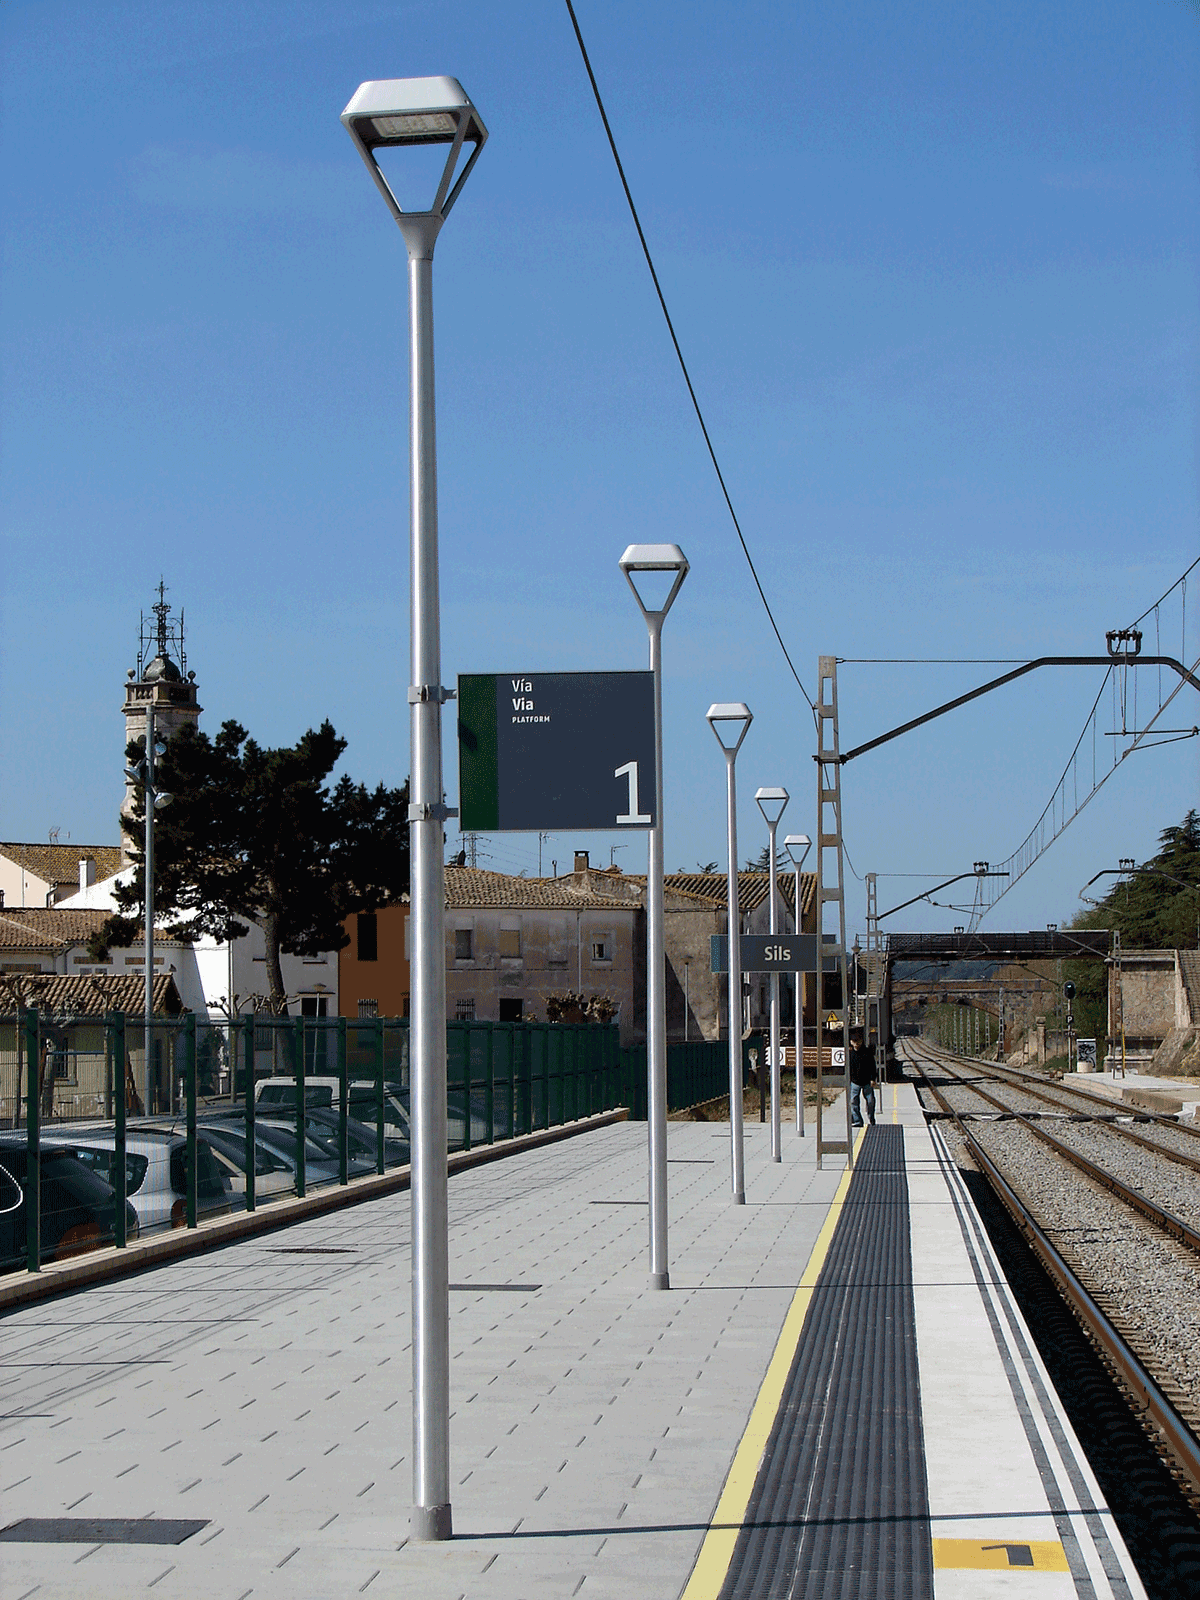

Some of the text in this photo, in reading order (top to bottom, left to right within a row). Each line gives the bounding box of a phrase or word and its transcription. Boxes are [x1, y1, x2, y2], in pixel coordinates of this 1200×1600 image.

[512, 678, 532, 692] Vía
[512, 697, 534, 711] Via
[614, 761, 652, 824] 1
[764, 945, 791, 961] Sils
